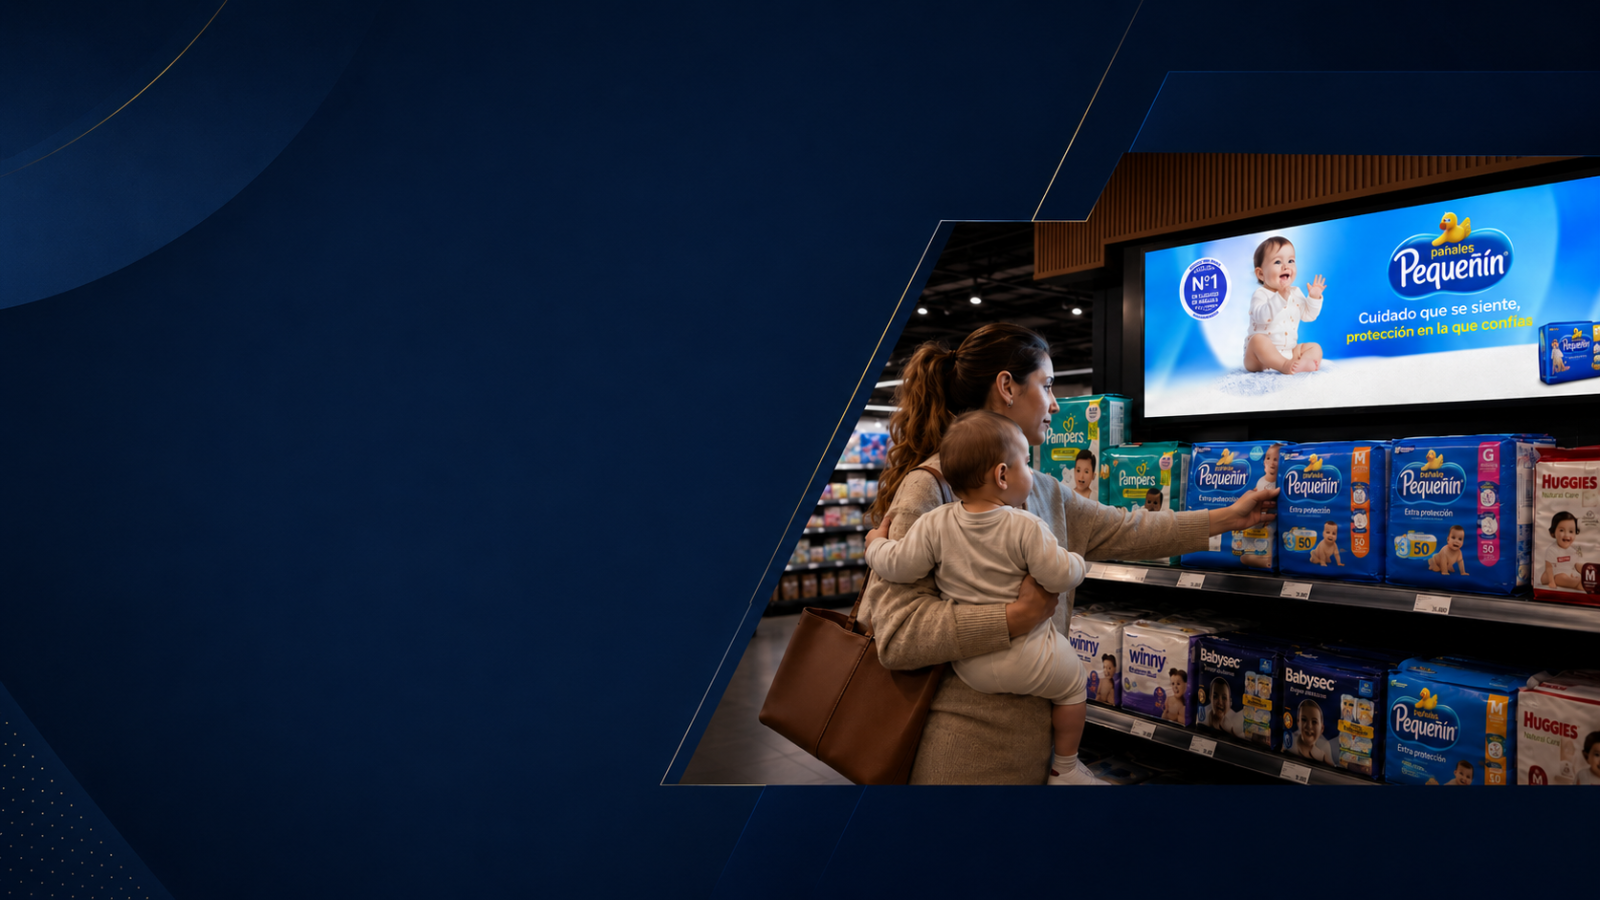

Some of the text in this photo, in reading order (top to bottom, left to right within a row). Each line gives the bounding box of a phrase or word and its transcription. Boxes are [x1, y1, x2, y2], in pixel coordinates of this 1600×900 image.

[1431, 243, 1475, 260] pañales
[1394, 248, 1505, 290] Pequeñín
[1359, 298, 1521, 324] Cuidado que se siente,
[1346, 326, 1414, 345] protección
[1417, 325, 1434, 336] en
[1437, 321, 1449, 334] la
[1452, 320, 1478, 336] que
[1046, 427, 1085, 447] Pampers
[1354, 451, 1366, 465] M
[1482, 448, 1494, 462] G
[1119, 469, 1156, 489] Pampers
[1198, 463, 1247, 489] Pequeñín
[1286, 470, 1338, 498] Pequeñín
[1400, 469, 1461, 500] Pequeñín
[1542, 473, 1598, 489] HUGGIES
[1565, 491, 1580, 499] Care
[1298, 537, 1311, 548] 50
[1414, 542, 1430, 555] 50
[1482, 544, 1494, 554] 50
[1585, 570, 1596, 581] M
[1070, 634, 1099, 657] winny
[1129, 647, 1166, 673] winny
[1200, 647, 1240, 669] Babysec
[1285, 667, 1335, 691] Babysec
[1490, 700, 1503, 715] M
[1393, 703, 1455, 742] Pequeñín
[1523, 710, 1578, 740] HUGGIES
[1397, 743, 1414, 756] Extra
